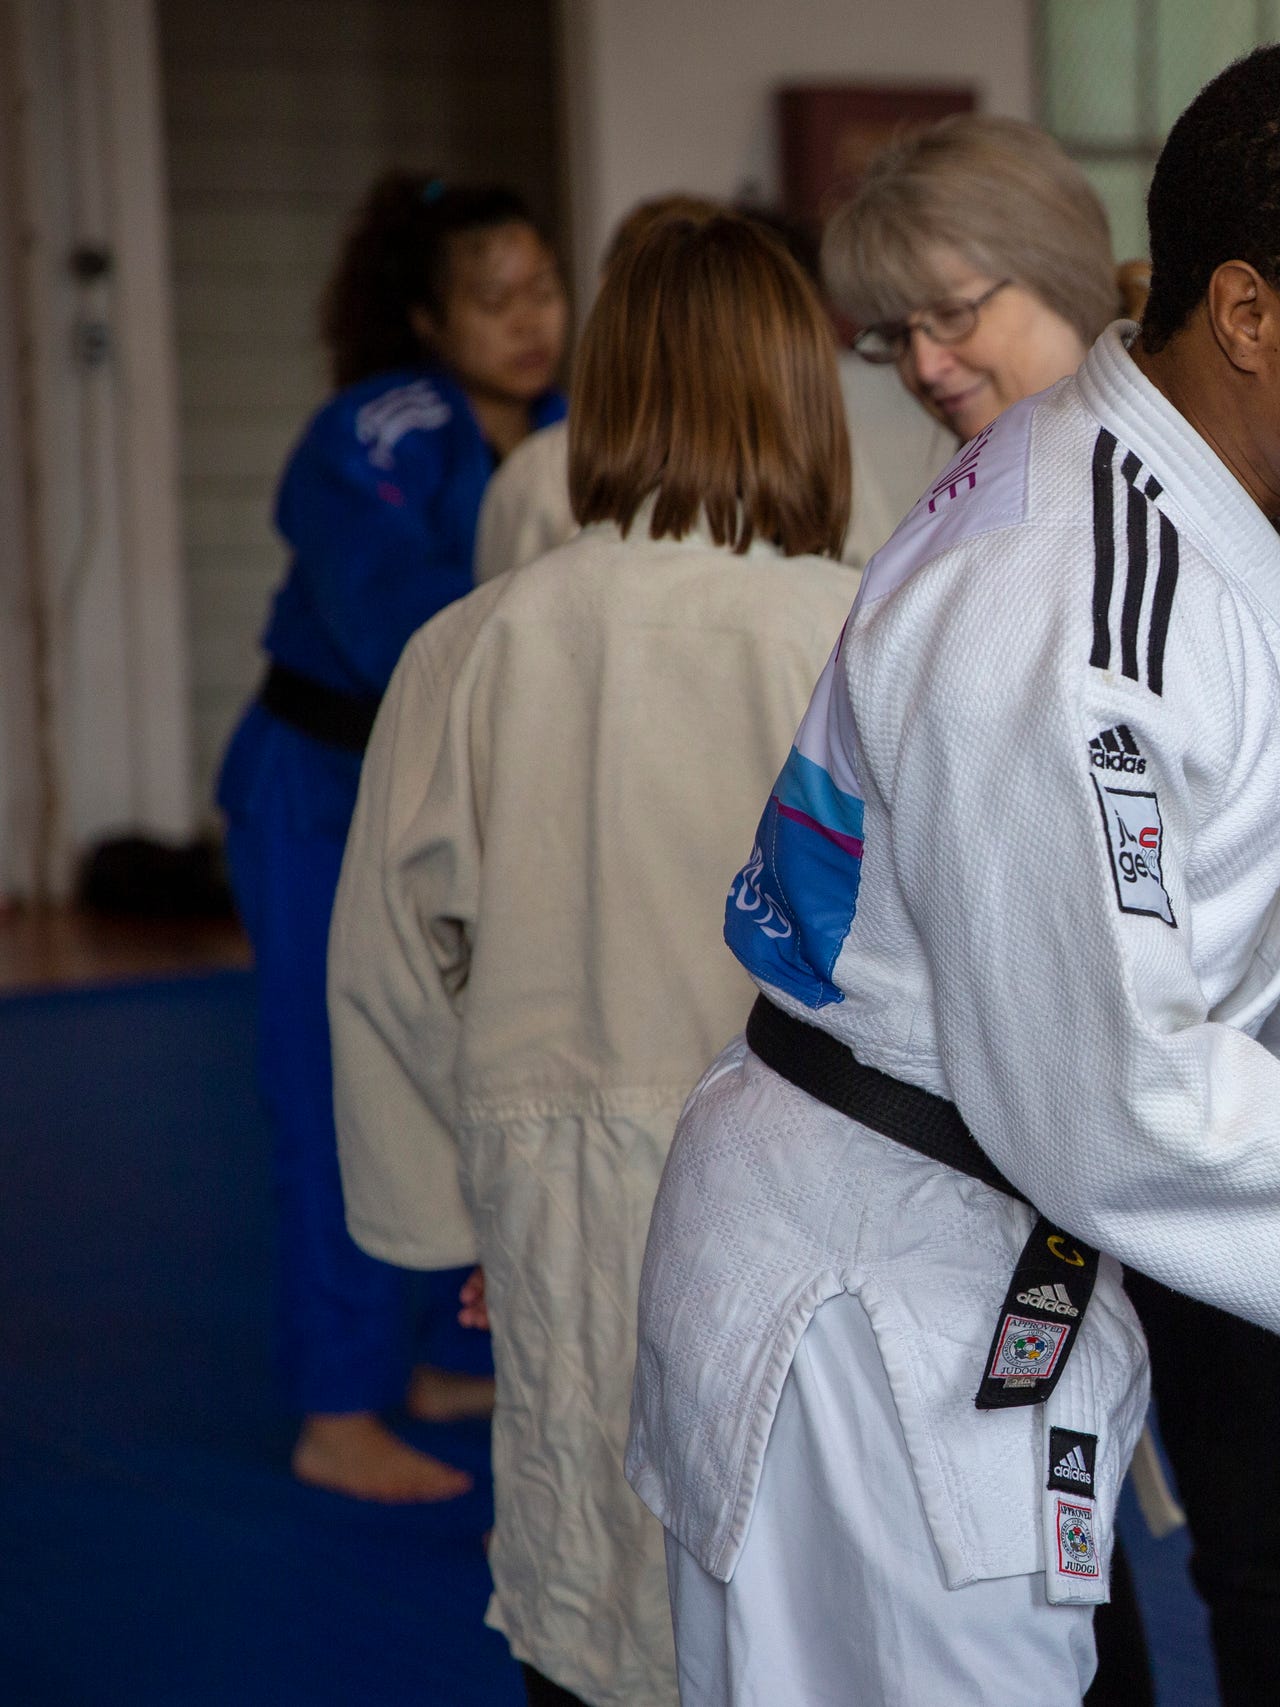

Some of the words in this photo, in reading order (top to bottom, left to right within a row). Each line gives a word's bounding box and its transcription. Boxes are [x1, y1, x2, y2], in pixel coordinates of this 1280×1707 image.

[1090, 750, 1146, 774] didas
[1017, 1292, 1079, 1317] adidas
[1010, 1320, 1063, 1333] APPROVED
[1054, 1466, 1091, 1484] adidas
[1065, 1561, 1095, 1574] JUDOGI
